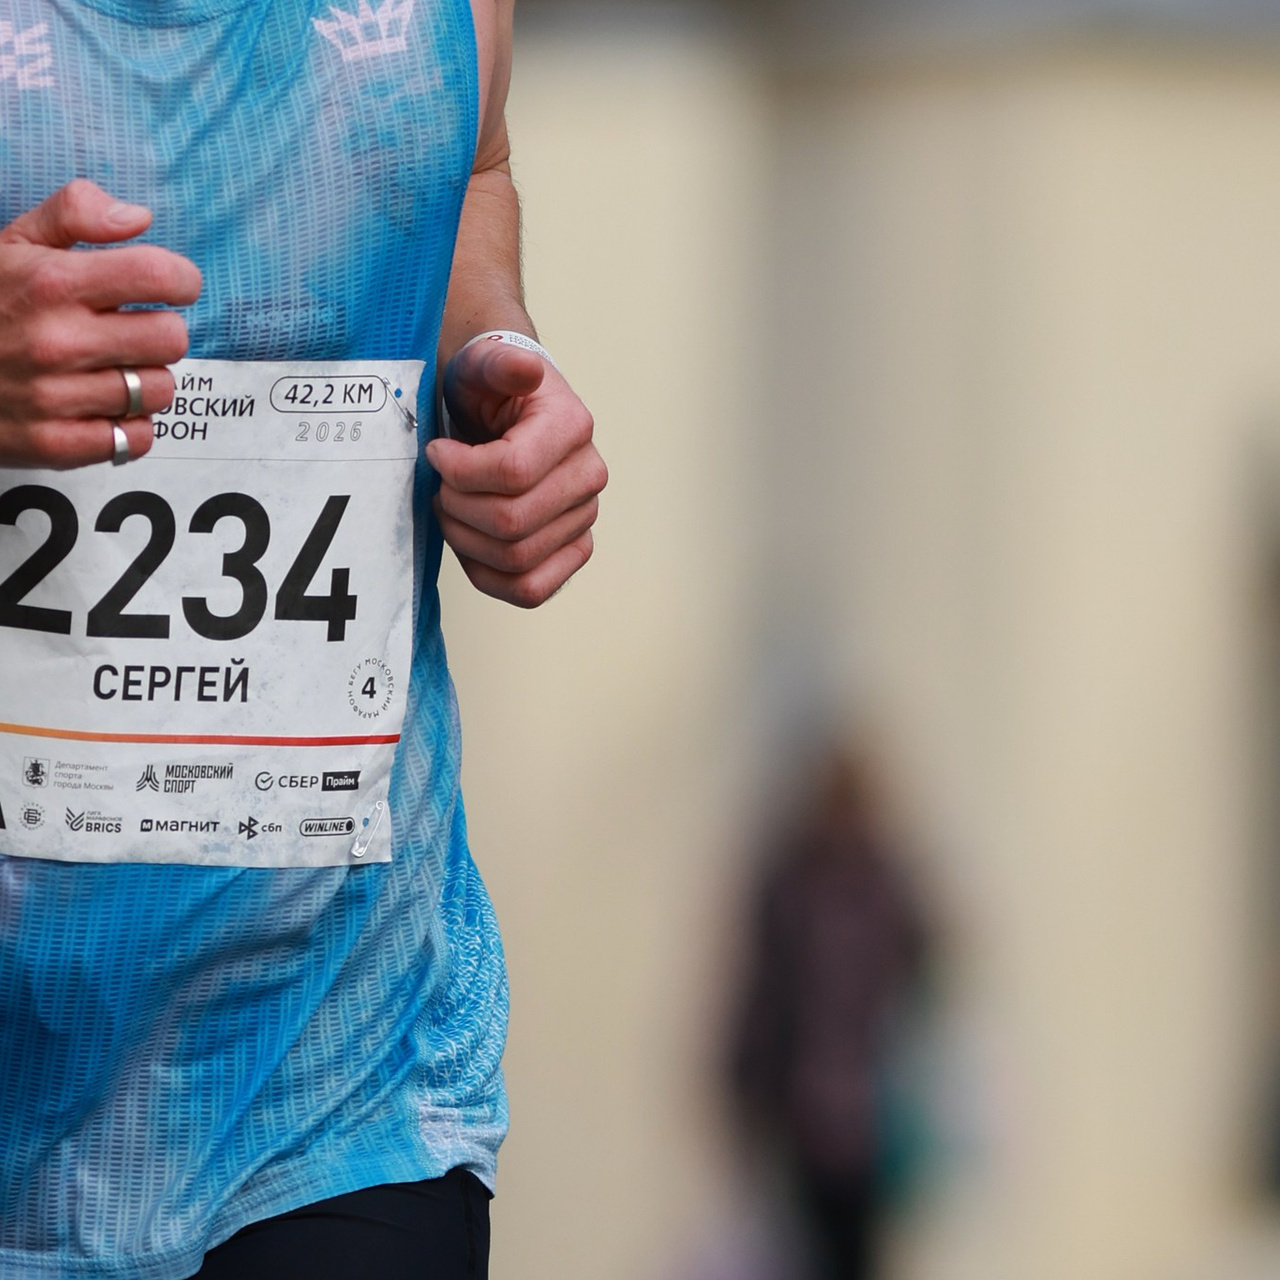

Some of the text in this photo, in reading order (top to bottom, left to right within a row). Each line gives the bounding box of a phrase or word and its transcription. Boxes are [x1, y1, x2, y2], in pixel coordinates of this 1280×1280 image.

[175, 373, 213, 392] ЙМ
[284, 383, 373, 407] 42,2 КМ
[295, 421, 363, 442] 2026
[93, 658, 250, 703] СЕРГЕЙ
[365, 658, 394, 711] МОСКОВСКИЙ
[361, 676, 377, 699] 4
[347, 690, 379, 719] МАРАФОН
[54, 761, 108, 771] Департамент
[165, 762, 233, 779] МОСКОВСКИЙ
[54, 771, 82, 780] спорта
[278, 775, 355, 788] СБЕР Прайм
[53, 780, 114, 791] города Москвы
[163, 780, 196, 793] СПОРТ
[85, 822, 122, 833] BRICS
[155, 820, 220, 832] магнит
[261, 822, 282, 832] сбп
[304, 822, 345, 832] WINLINE
